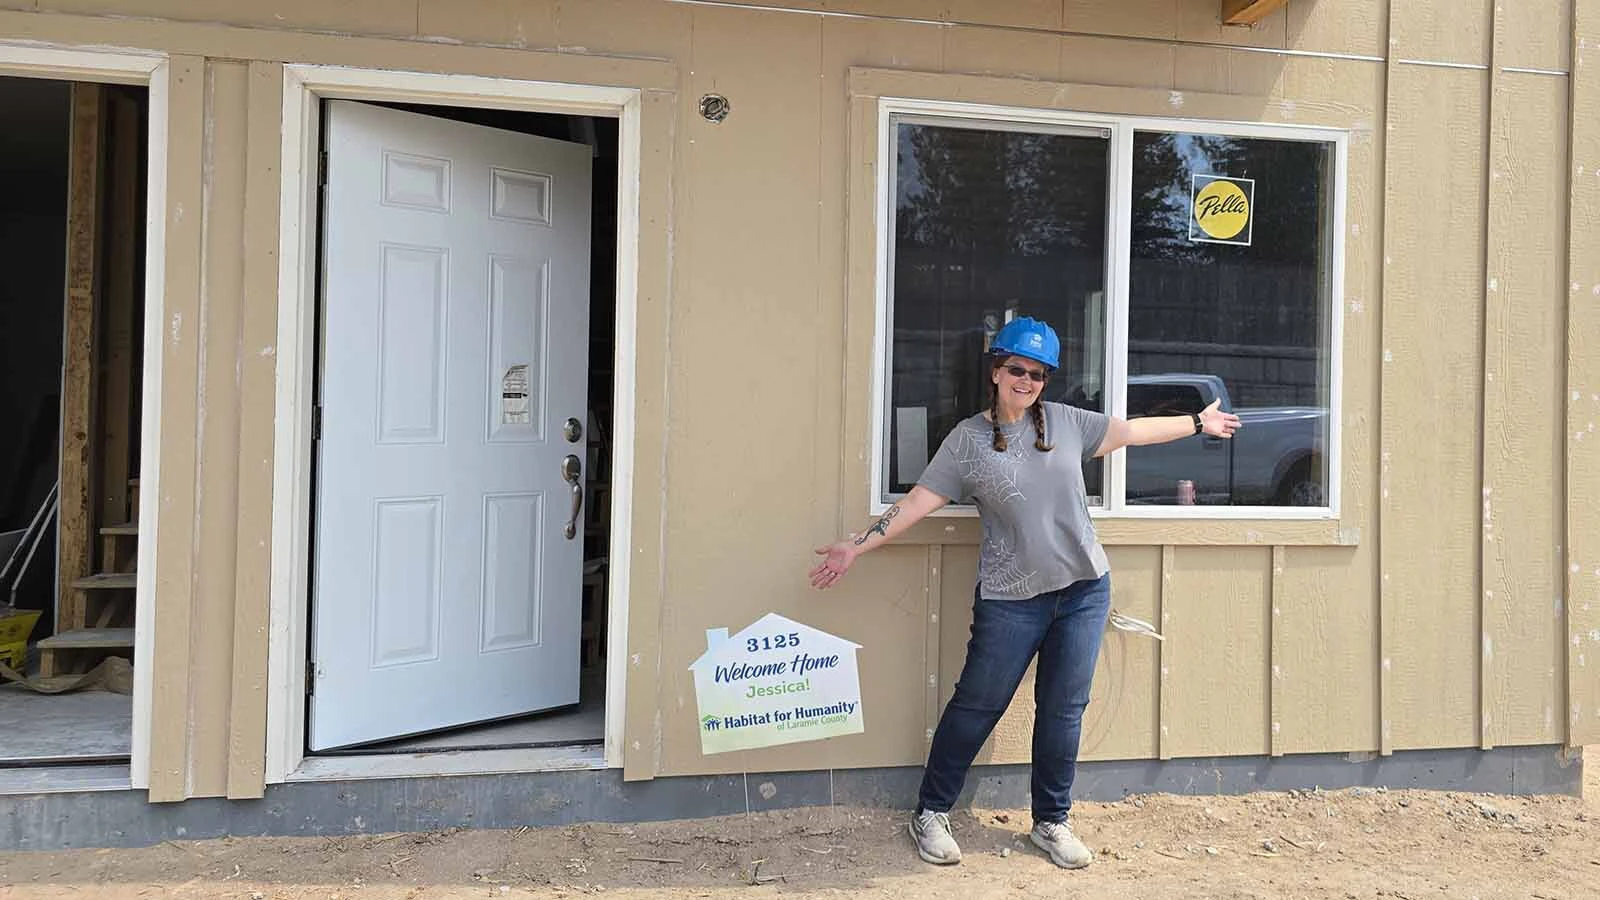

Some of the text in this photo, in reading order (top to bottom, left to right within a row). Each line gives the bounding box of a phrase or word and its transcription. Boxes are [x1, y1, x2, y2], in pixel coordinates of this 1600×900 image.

[1199, 194, 1245, 220] Pella
[747, 632, 800, 652] 3125
[715, 653, 839, 683] Welcome Home
[745, 678, 811, 699] Jessica!
[724, 702, 855, 730] Habitat for Humanity
[776, 713, 848, 731] of Laramie County
